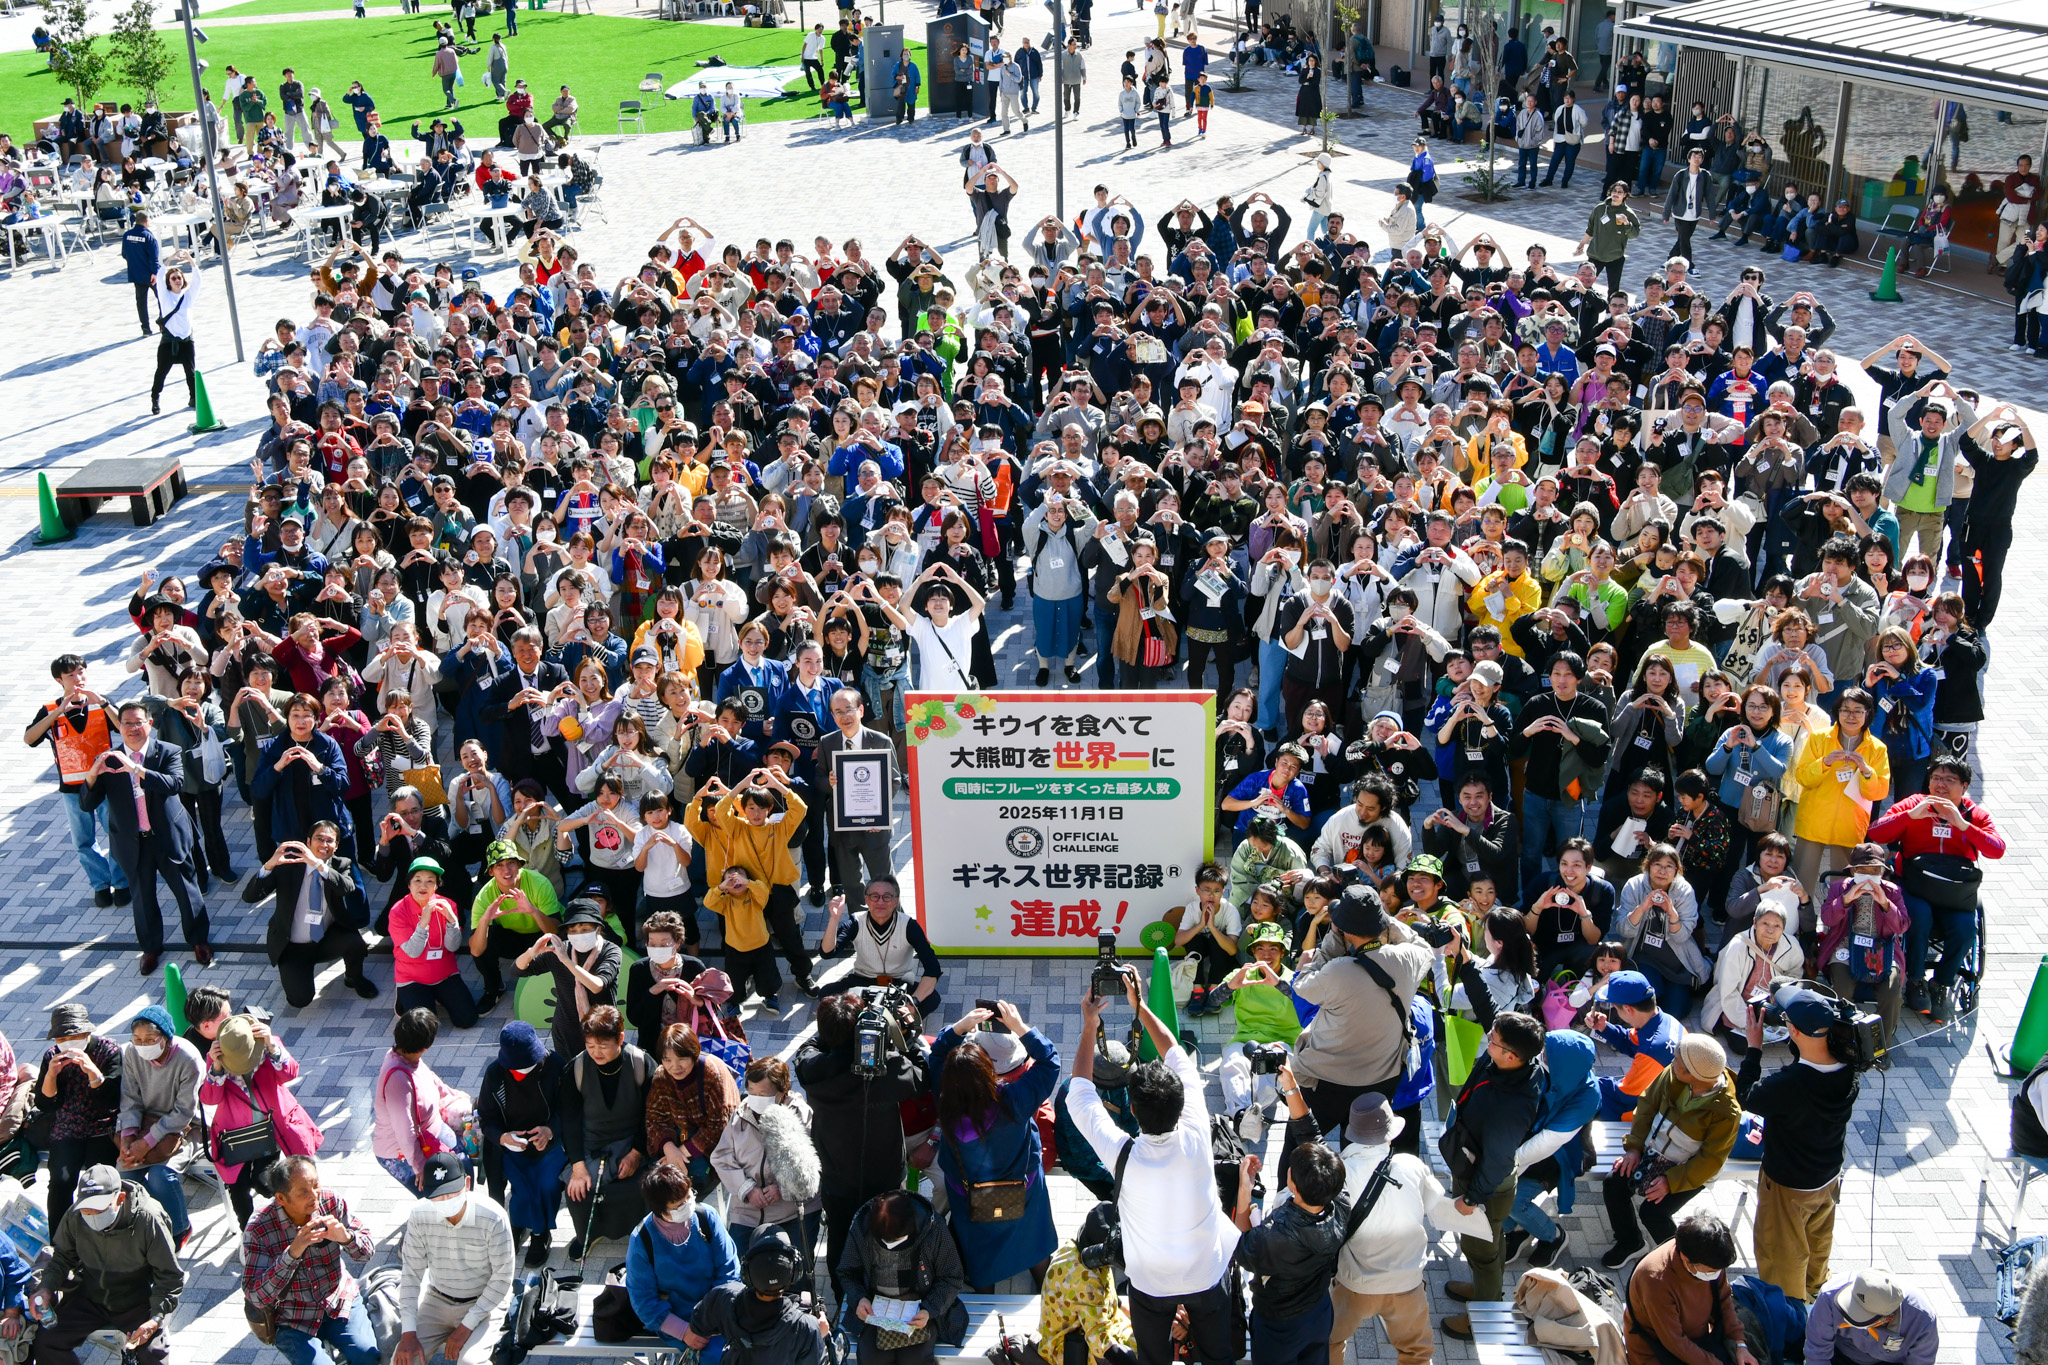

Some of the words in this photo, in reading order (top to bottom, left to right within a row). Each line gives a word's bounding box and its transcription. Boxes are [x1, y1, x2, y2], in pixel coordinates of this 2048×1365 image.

[947, 665, 956, 673] 24
[482, 679, 491, 687] 31
[1880, 699, 1890, 711] 143
[972, 714, 1153, 737] キウイを食べて
[1637, 738, 1650, 747] 127
[949, 741, 1175, 769] 大熊町を世界一に
[1736, 773, 1749, 784] 116
[1838, 771, 1852, 780] 117
[954, 782, 1170, 795] 同時にフルーツをすくった最多人数
[999, 805, 1123, 821] 2025年11月1日
[1011, 827, 1039, 837] GUINNESS
[1052, 832, 1119, 842] OFFICIAL
[1934, 828, 1949, 836] 374
[1052, 844, 1119, 853] CHALLENGE
[1560, 933, 1573, 941] 100
[1647, 936, 1661, 946] 101
[1857, 936, 1871, 946] 104
[1364, 941, 1381, 950] Nikon
